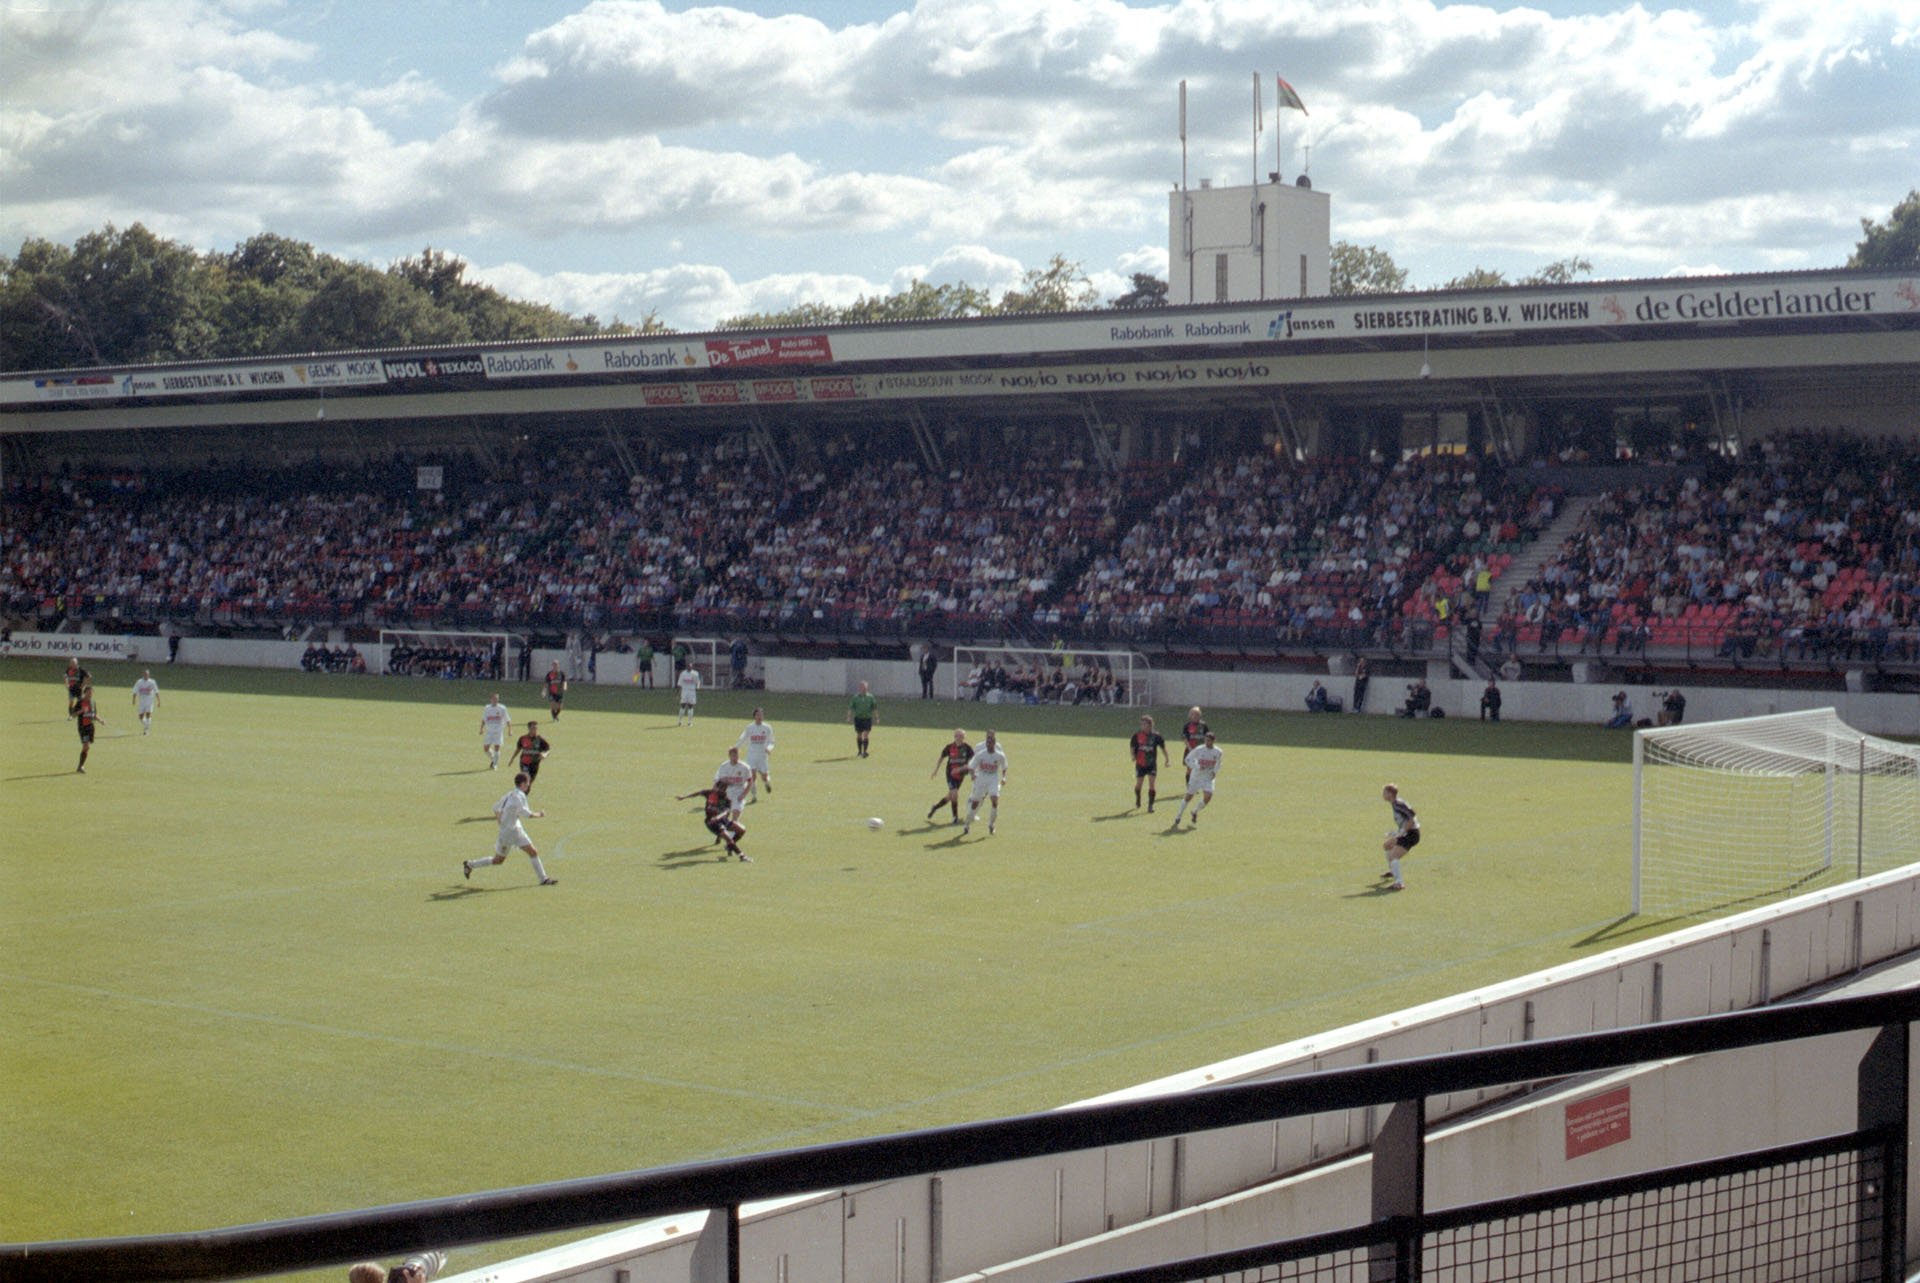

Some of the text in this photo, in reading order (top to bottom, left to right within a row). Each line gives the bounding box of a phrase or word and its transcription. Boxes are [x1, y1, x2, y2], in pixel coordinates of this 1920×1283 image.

[1635, 286, 1876, 321] de Gelderlander
[1354, 306, 1478, 329] SIERBESTRATING
[1483, 306, 1511, 324] B.V.
[1520, 301, 1589, 322] WIJCHEN
[1110, 320, 1251, 341] Rabobank Rabobank
[346, 360, 378, 376] MOOK
[440, 360, 483, 374] TEXACO
[486, 353, 555, 373] Rabobank
[604, 347, 679, 369] Rabobank
[707, 351, 730, 366] De
[162, 374, 228, 390] SIERBESTRATING
